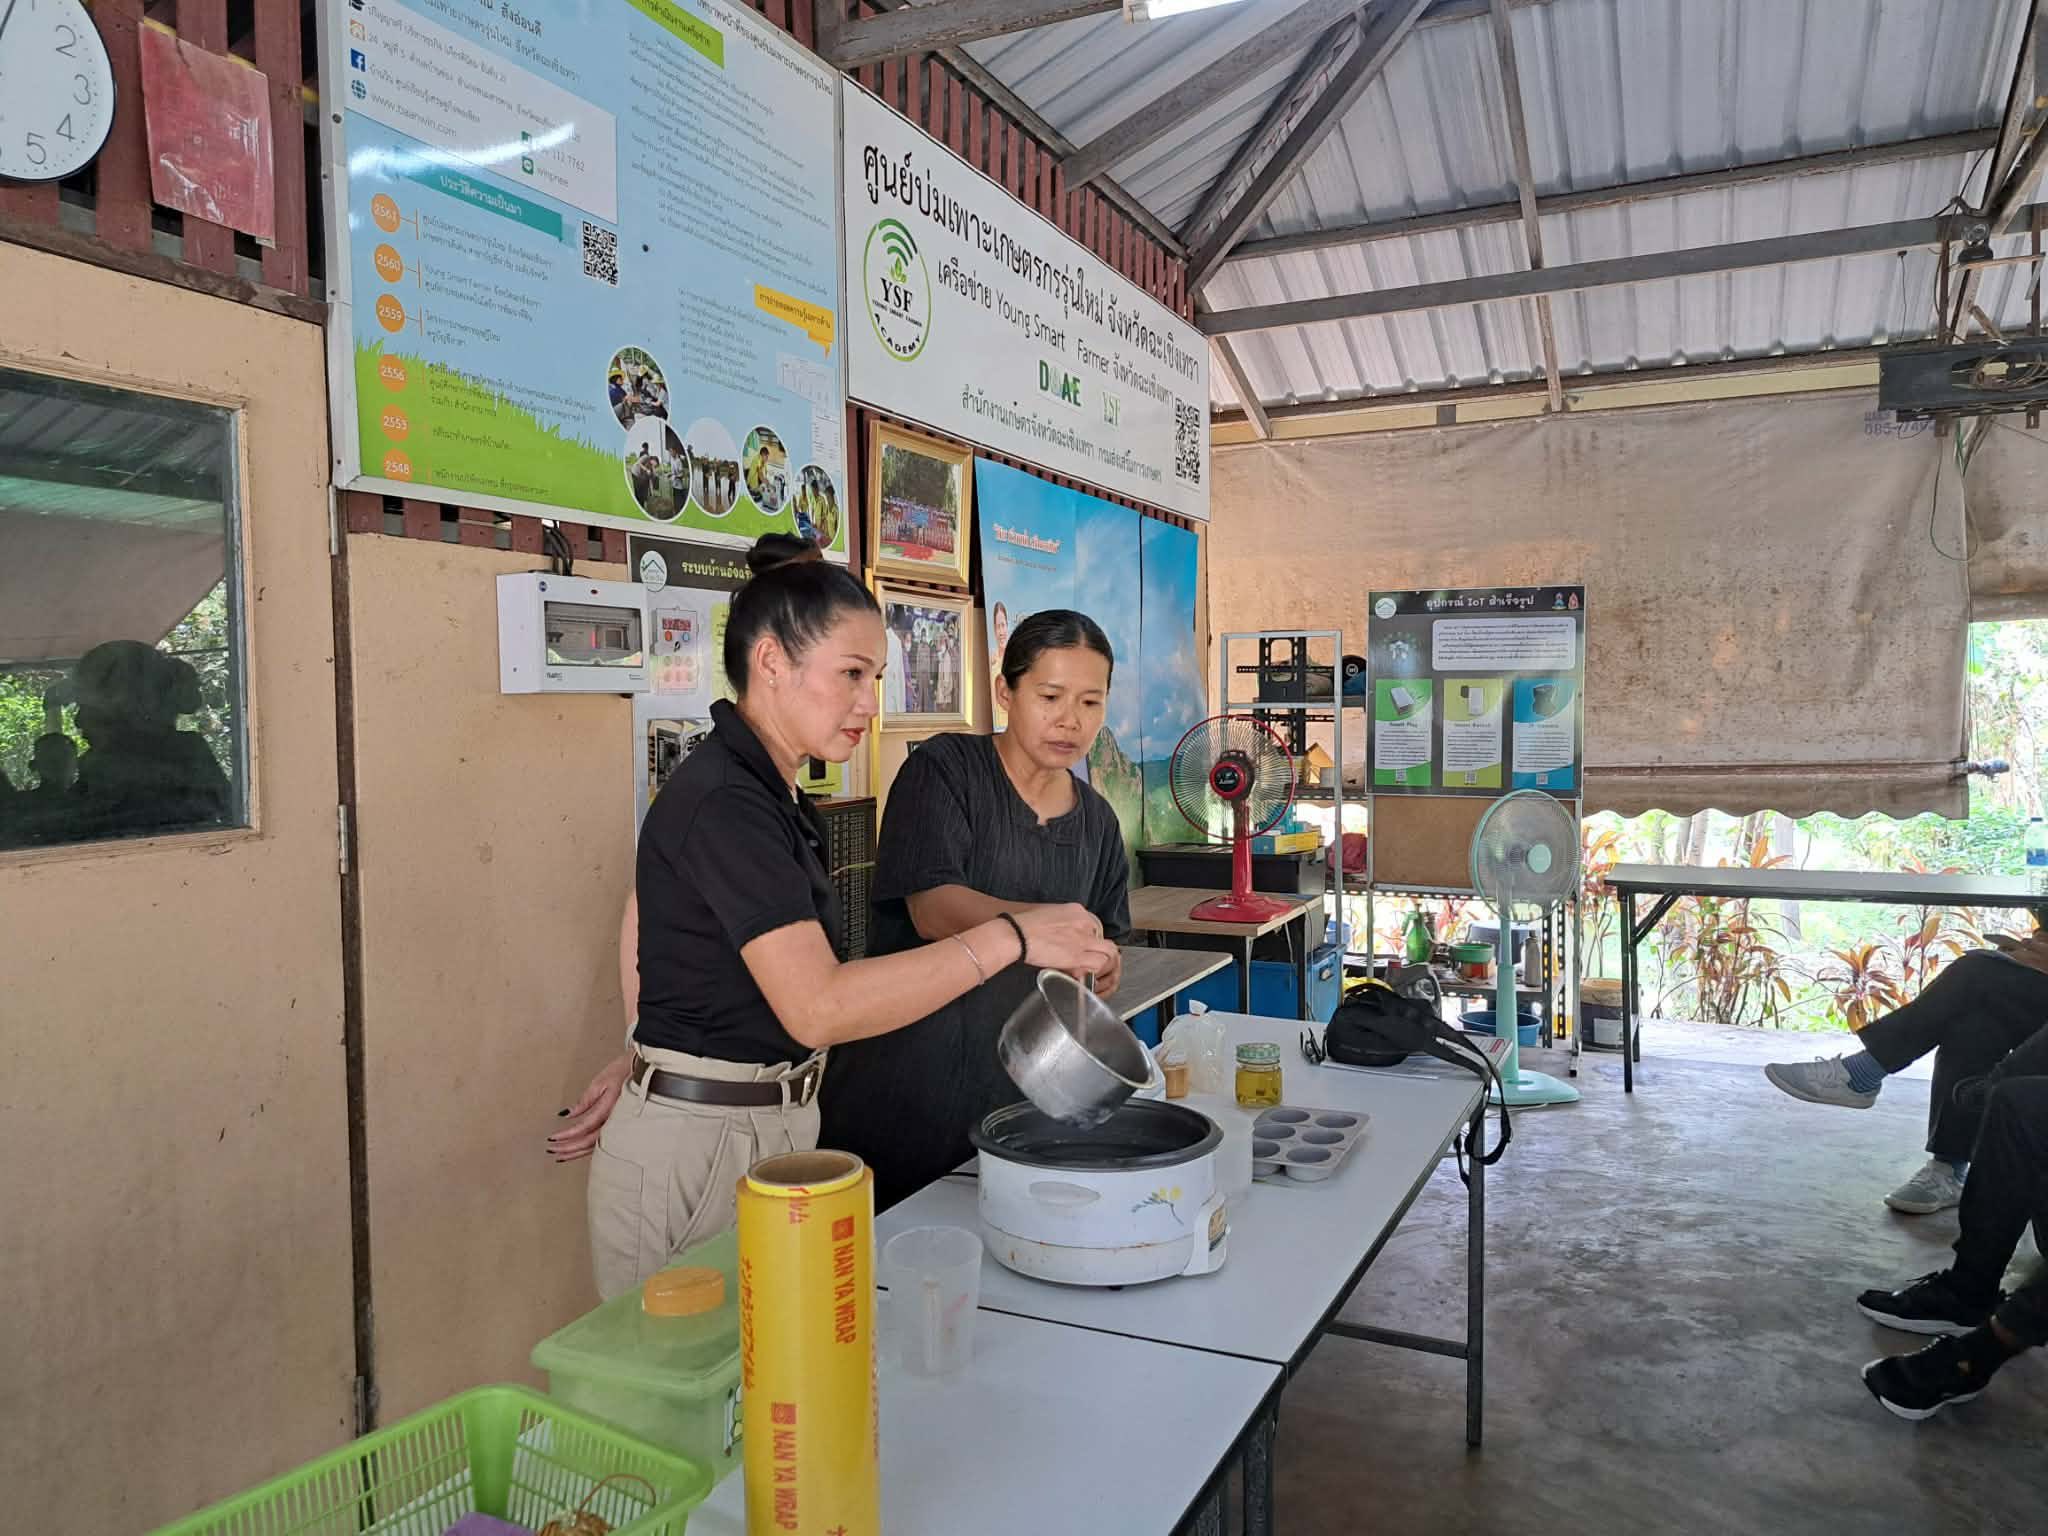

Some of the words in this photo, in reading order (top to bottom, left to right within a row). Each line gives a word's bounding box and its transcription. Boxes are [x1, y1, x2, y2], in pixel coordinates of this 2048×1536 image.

[56, 25, 77, 58] 2
[73, 74, 91, 105] 3
[56, 113, 75, 142] 4
[26, 132, 47, 165] 5
[439, 173, 522, 216] ประวัติความเป็นมา
[376, 254, 400, 271] 2560
[863, 145, 1103, 325] ศูนย์บ่มเพาะเกษตรกรรุ่นใหม่
[1106, 291, 1198, 383] จังหวัดฉะเชิงเทรา
[880, 277, 912, 312] YSF
[378, 305, 401, 321] 2559
[874, 313, 920, 354] ACADEMY
[937, 255, 992, 310] เครือข่าย
[996, 289, 1030, 339] Young
[1032, 310, 1066, 353] Smart
[1077, 337, 1111, 377] Farmer
[1113, 352, 1173, 409] จังหวัดฉะเชิงเทรา
[961, 384, 1093, 458] สำนักงานเกษตรจังหวัดฉะเชิงเทรา
[681, 558, 752, 580] ระบบบ้านอัจฉริ
[1426, 596, 1464, 612] อุปกรณ์
[1467, 597, 1485, 607] IoT
[1489, 592, 1535, 609] สำเร็จรูป
[834, 1242, 855, 1279] NAN
[834, 1278, 856, 1302] YA
[834, 1300, 857, 1345] WRAP
[774, 1430, 797, 1462] NAN
[774, 1466, 797, 1484] YA
[775, 1487, 798, 1531] WRAP
